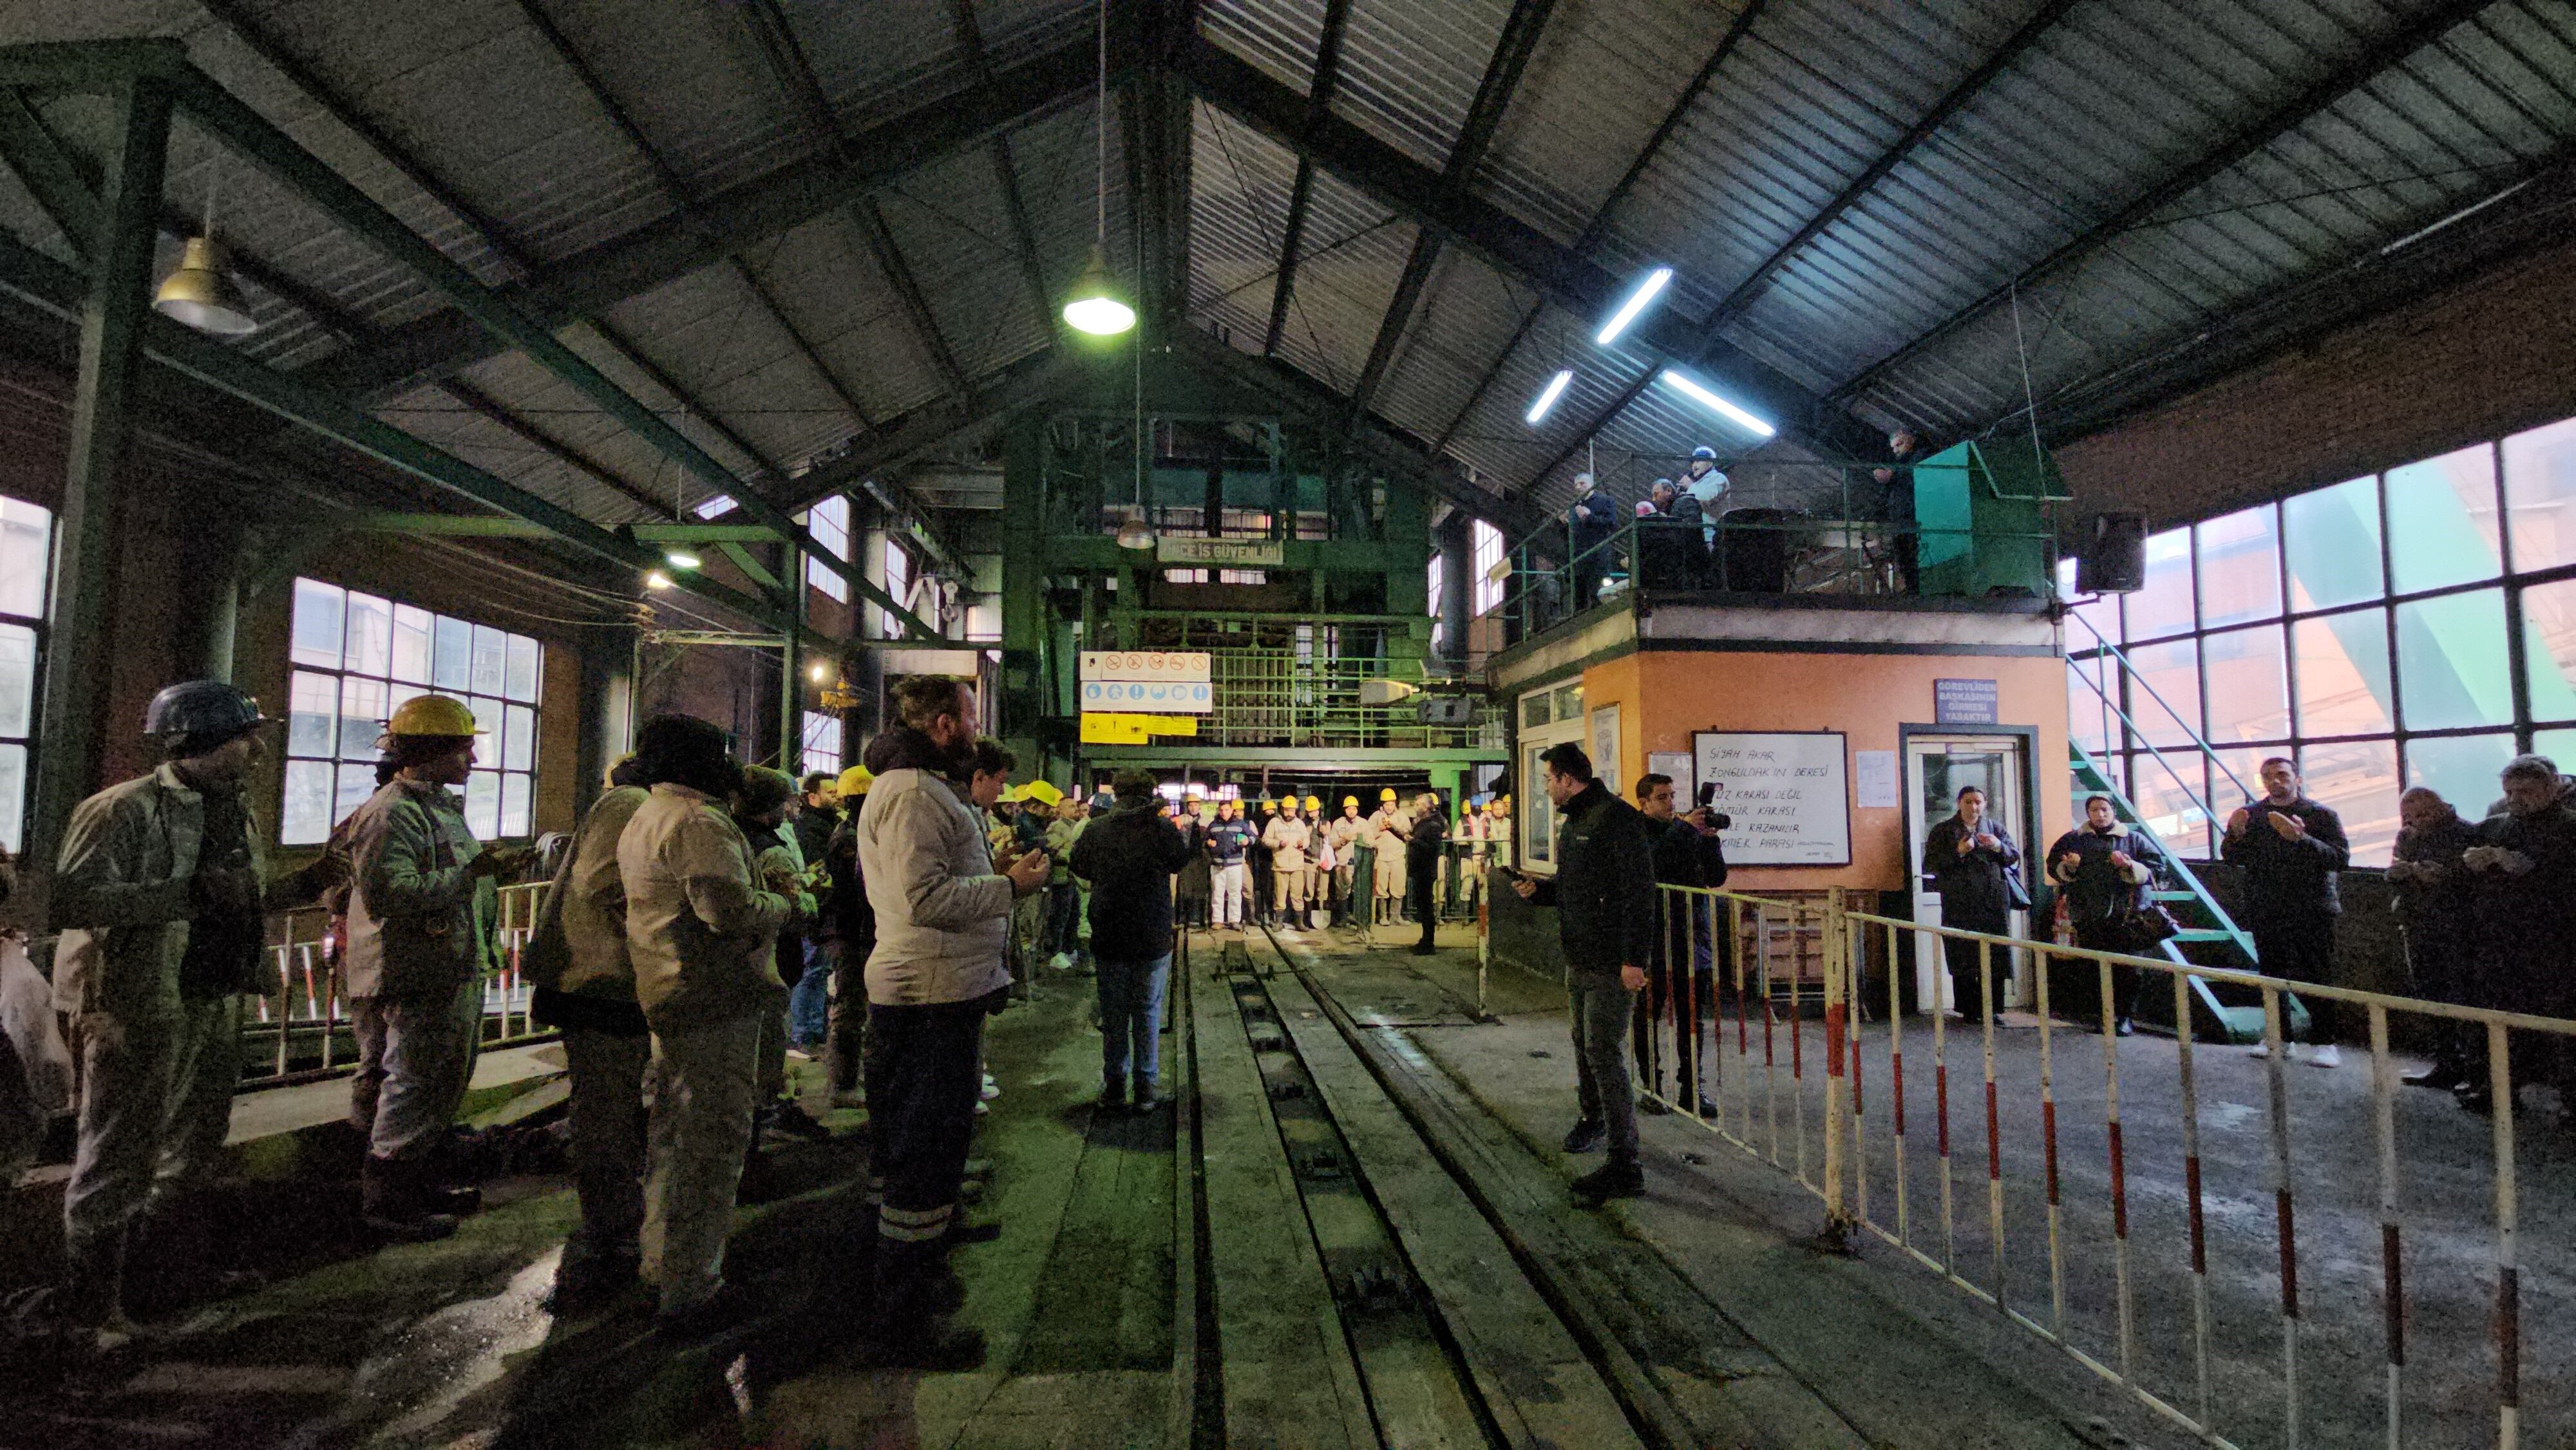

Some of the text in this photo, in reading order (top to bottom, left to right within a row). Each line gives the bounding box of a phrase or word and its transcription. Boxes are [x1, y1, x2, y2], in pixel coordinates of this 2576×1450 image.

[1747, 750, 1776, 762] AKAR
[1736, 790, 1770, 800] KARASI
[1757, 806, 1795, 816] KARASI
[1721, 838, 1751, 849] KMEK
[1759, 838, 1794, 849] PARASI
